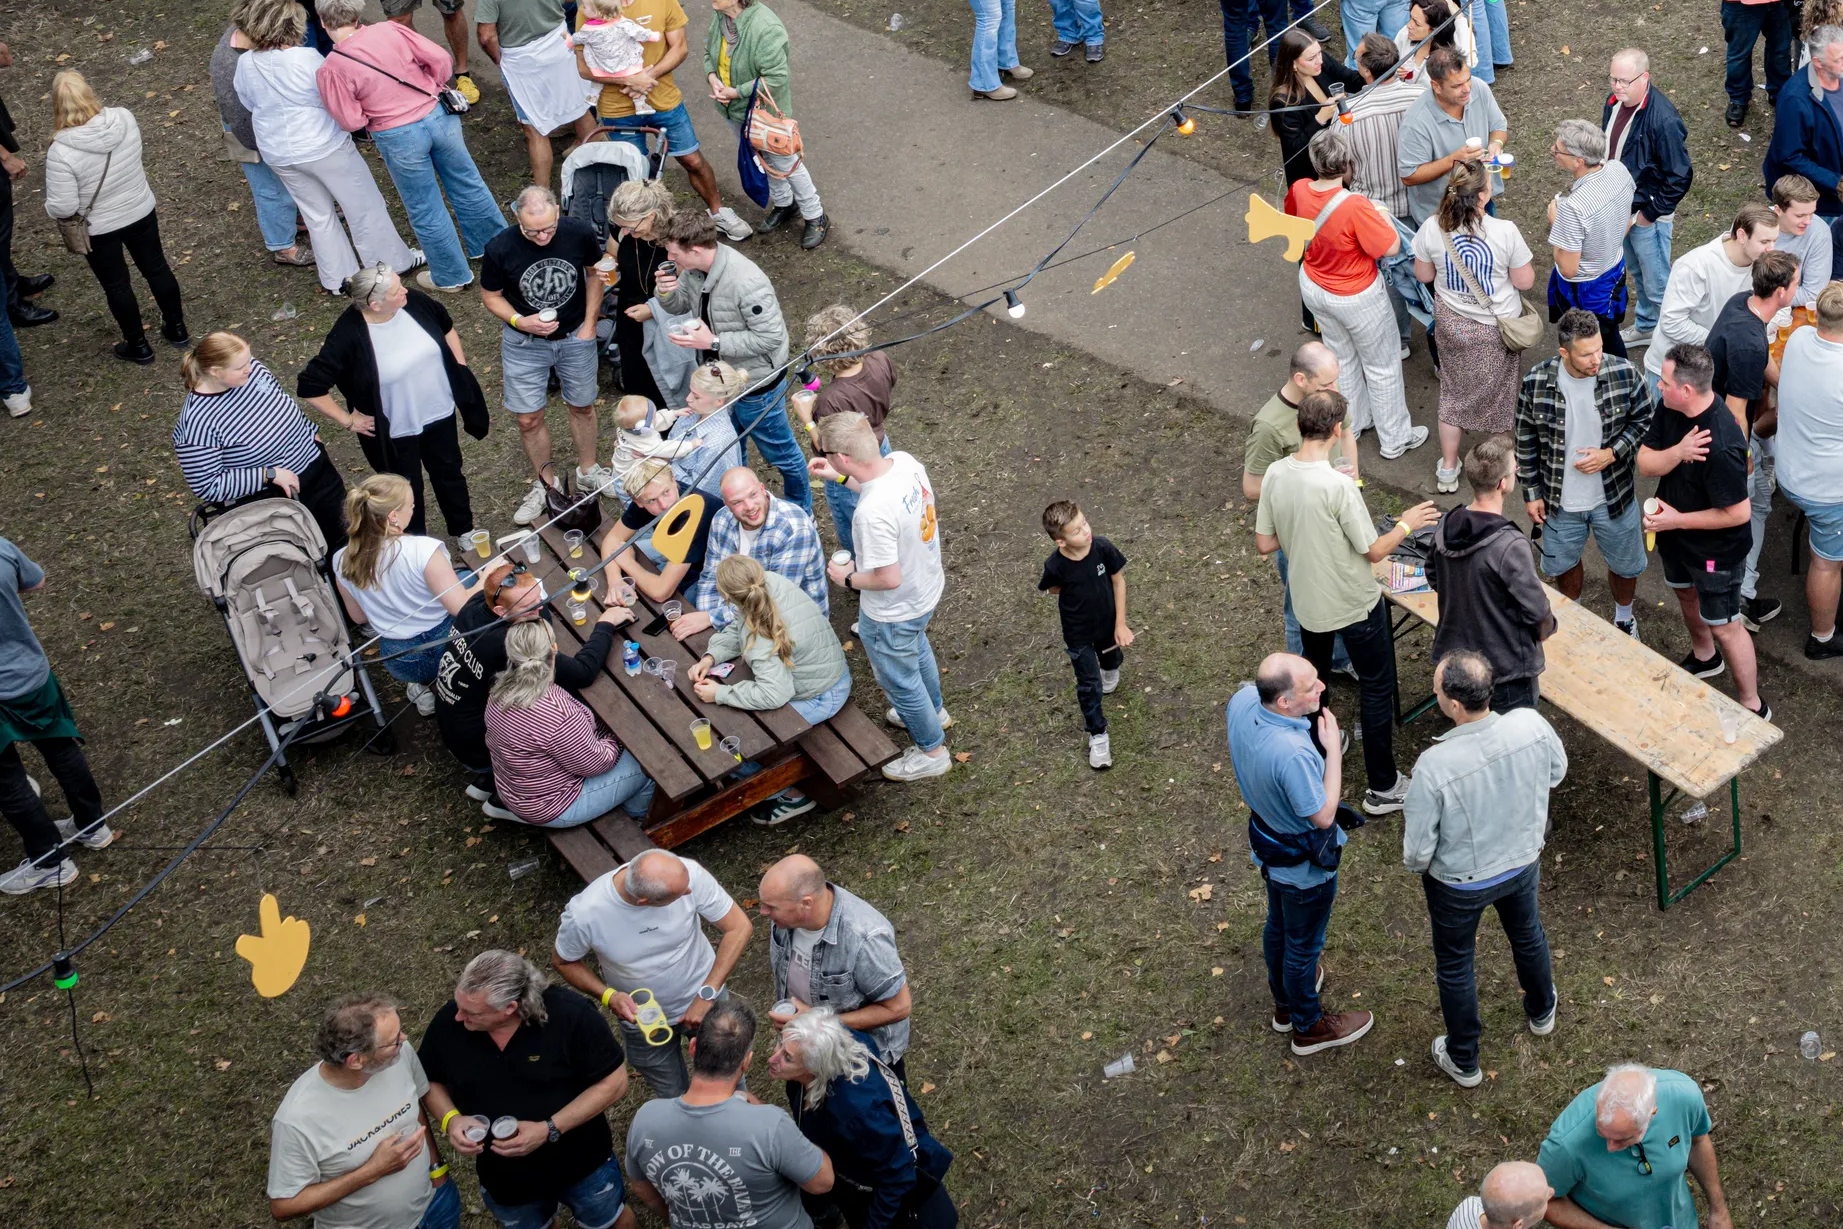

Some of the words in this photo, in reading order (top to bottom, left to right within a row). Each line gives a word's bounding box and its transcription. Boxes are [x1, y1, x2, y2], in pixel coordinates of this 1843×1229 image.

[464, 650, 484, 680] CLUB
[667, 1143, 694, 1160] OF
[697, 1145, 735, 1179] THE
